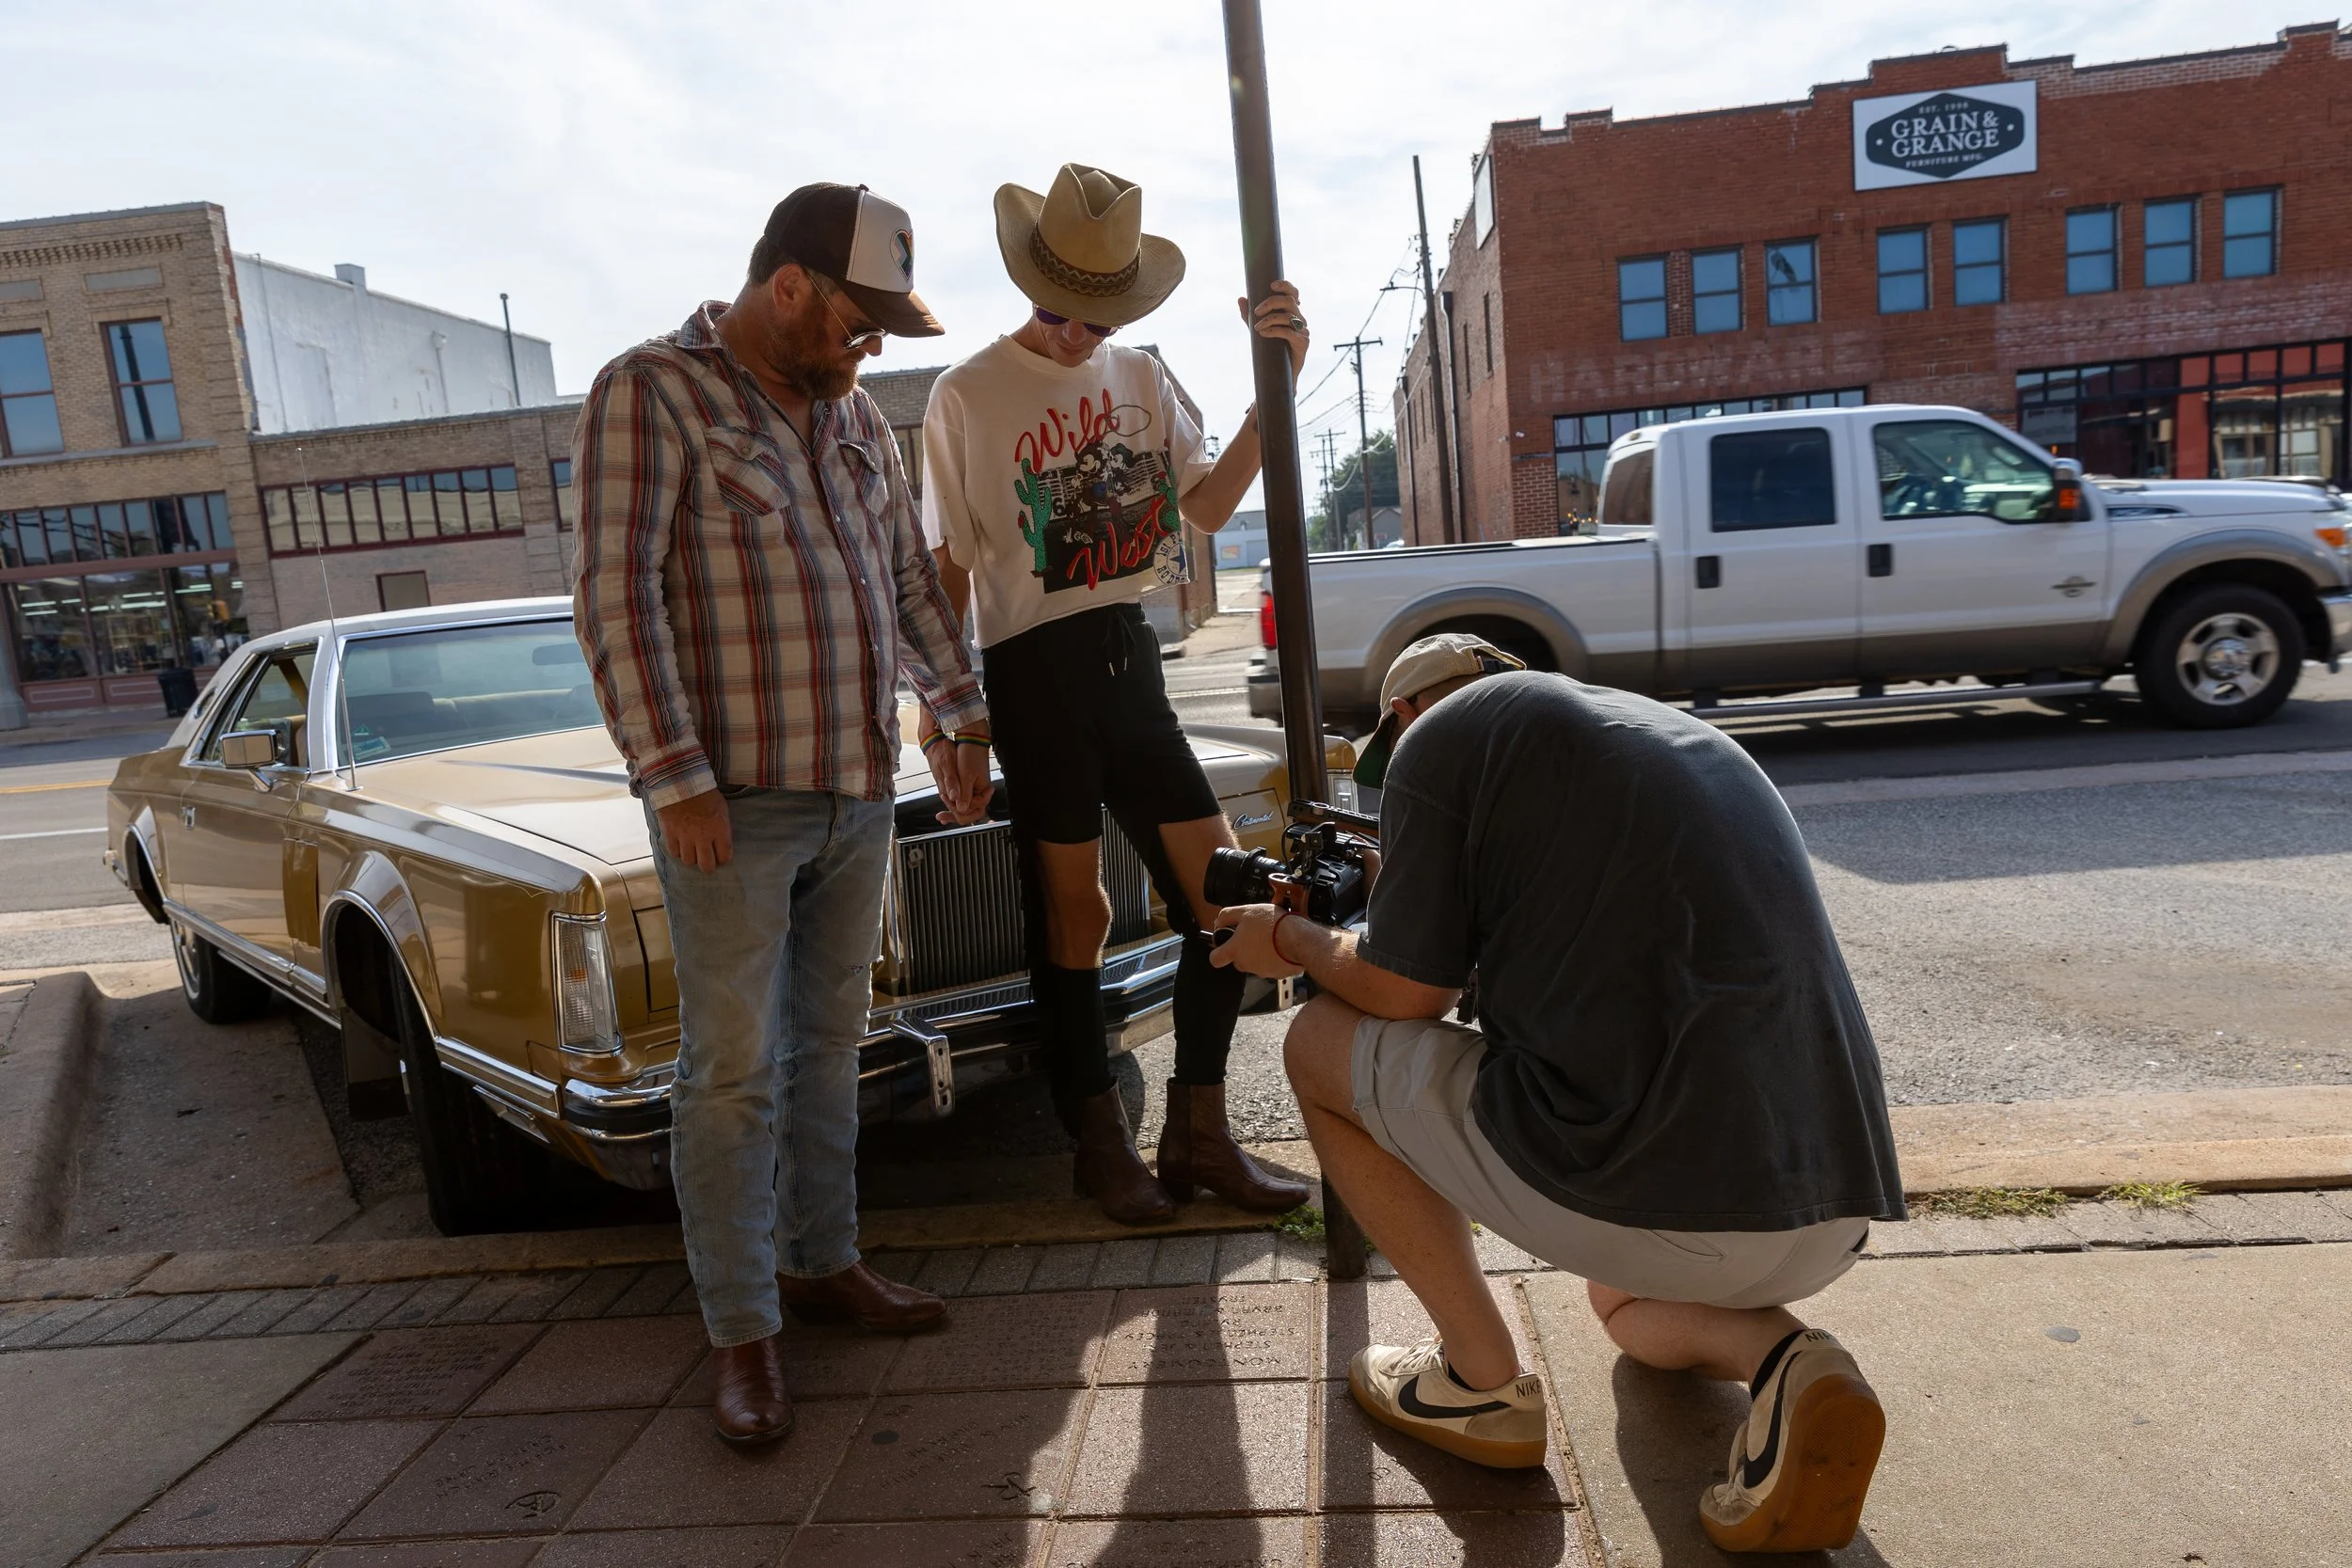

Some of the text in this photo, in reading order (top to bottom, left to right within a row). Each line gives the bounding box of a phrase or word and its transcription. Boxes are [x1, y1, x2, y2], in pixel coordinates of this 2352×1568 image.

[1891, 110, 1999, 138] GRAIN &
[1891, 128, 1999, 158] GRANGE
[1014, 388, 1120, 474] Wild
[1066, 493, 1170, 591] West
[1233, 811, 1274, 830] Continental
[1516, 1379, 1541, 1399] NIKE
